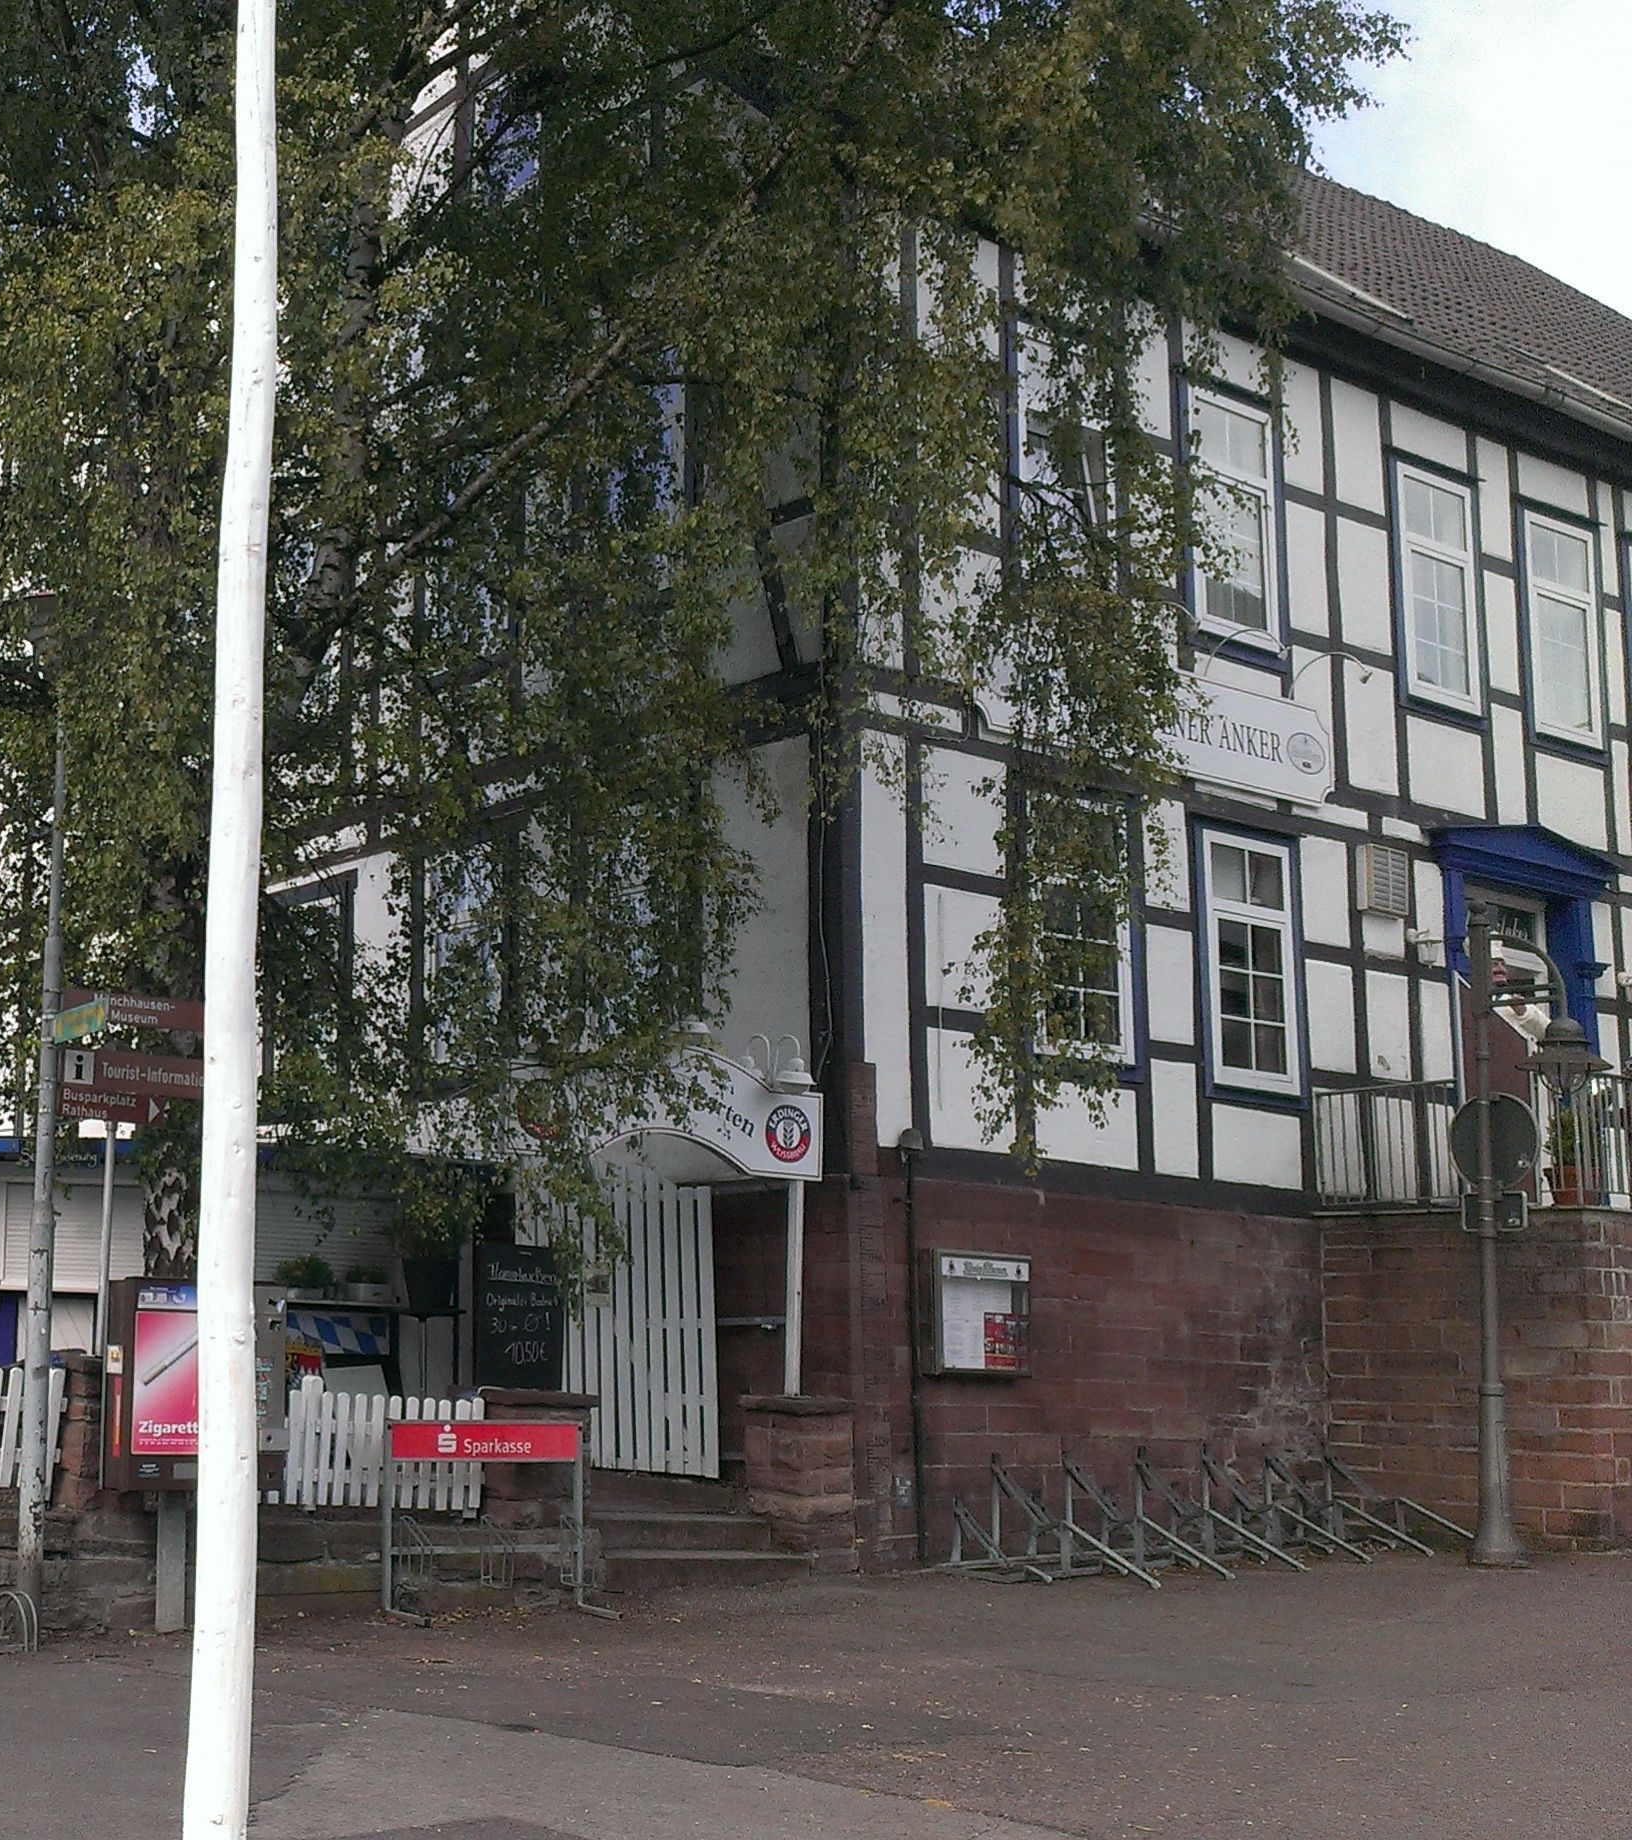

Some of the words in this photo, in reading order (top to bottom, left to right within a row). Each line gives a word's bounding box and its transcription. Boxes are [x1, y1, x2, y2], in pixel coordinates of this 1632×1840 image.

[1218, 717, 1284, 764] ANKER
[94, 992, 176, 1012] Mnchhausen-
[111, 1009, 159, 1025] Museum
[102, 1061, 205, 1088] Tourist-Informatio
[62, 1087, 138, 1108] Busparkplatz
[61, 1103, 108, 1119] Rathaus
[768, 1107, 809, 1132] ERDINGER
[138, 1419, 199, 1438] Zigarett
[463, 1437, 532, 1457] Sparkasse
